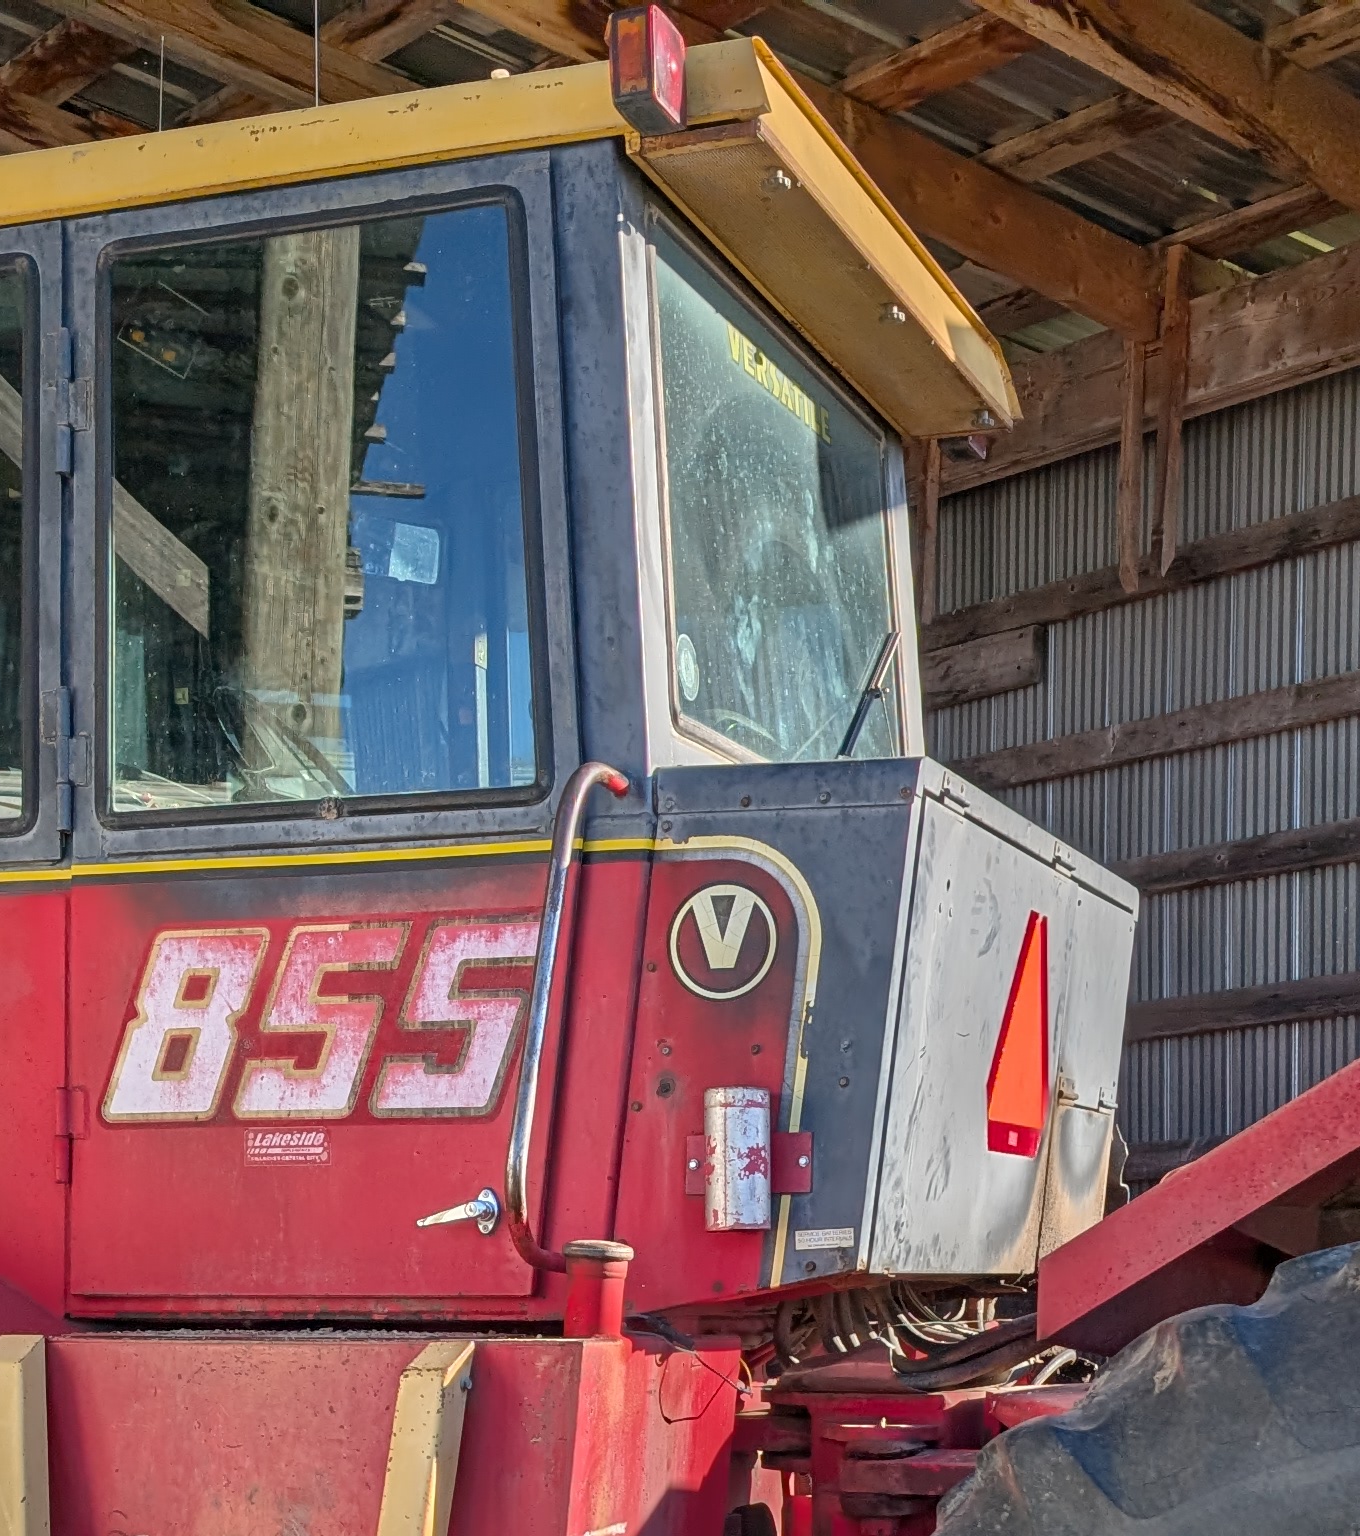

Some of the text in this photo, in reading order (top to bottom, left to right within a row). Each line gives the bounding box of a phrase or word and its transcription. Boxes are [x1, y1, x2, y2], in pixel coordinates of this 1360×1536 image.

[727, 323, 832, 446] VERSATILE
[691, 886, 758, 970] V
[101, 914, 540, 1123] 855
[254, 1131, 325, 1146] Lakeside
